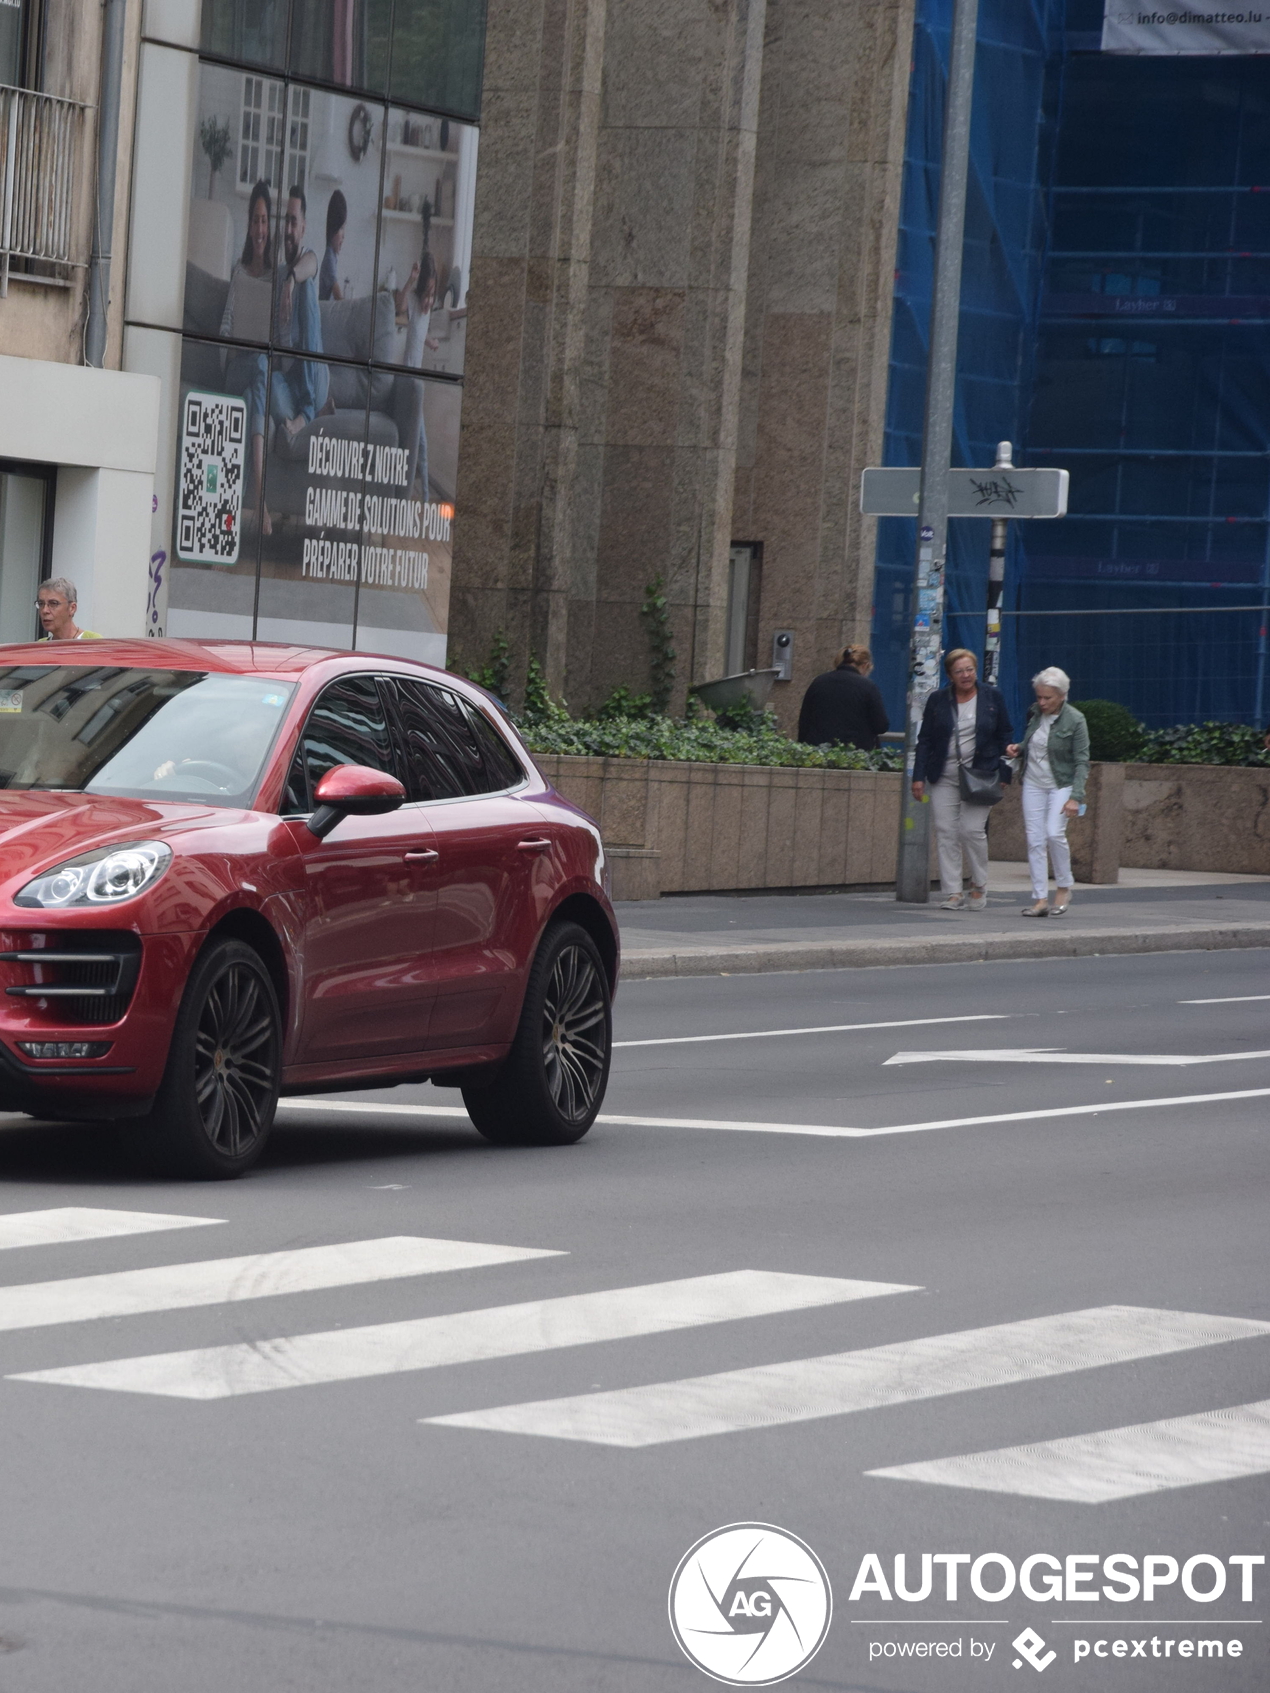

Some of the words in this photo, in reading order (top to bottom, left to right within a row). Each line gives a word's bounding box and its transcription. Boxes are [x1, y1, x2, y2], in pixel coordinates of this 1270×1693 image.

[1137, 10, 1262, 25] info@dimatteo.lu
[374, 445, 410, 486] NOTRE
[305, 486, 347, 529] GAMME
[346, 491, 362, 531] DE
[363, 494, 422, 539] SOLUTIONS
[422, 502, 451, 542] POUR
[302, 531, 359, 581] PRÉPARER
[361, 545, 395, 586] VOTRE
[394, 549, 429, 590] FUTUR
